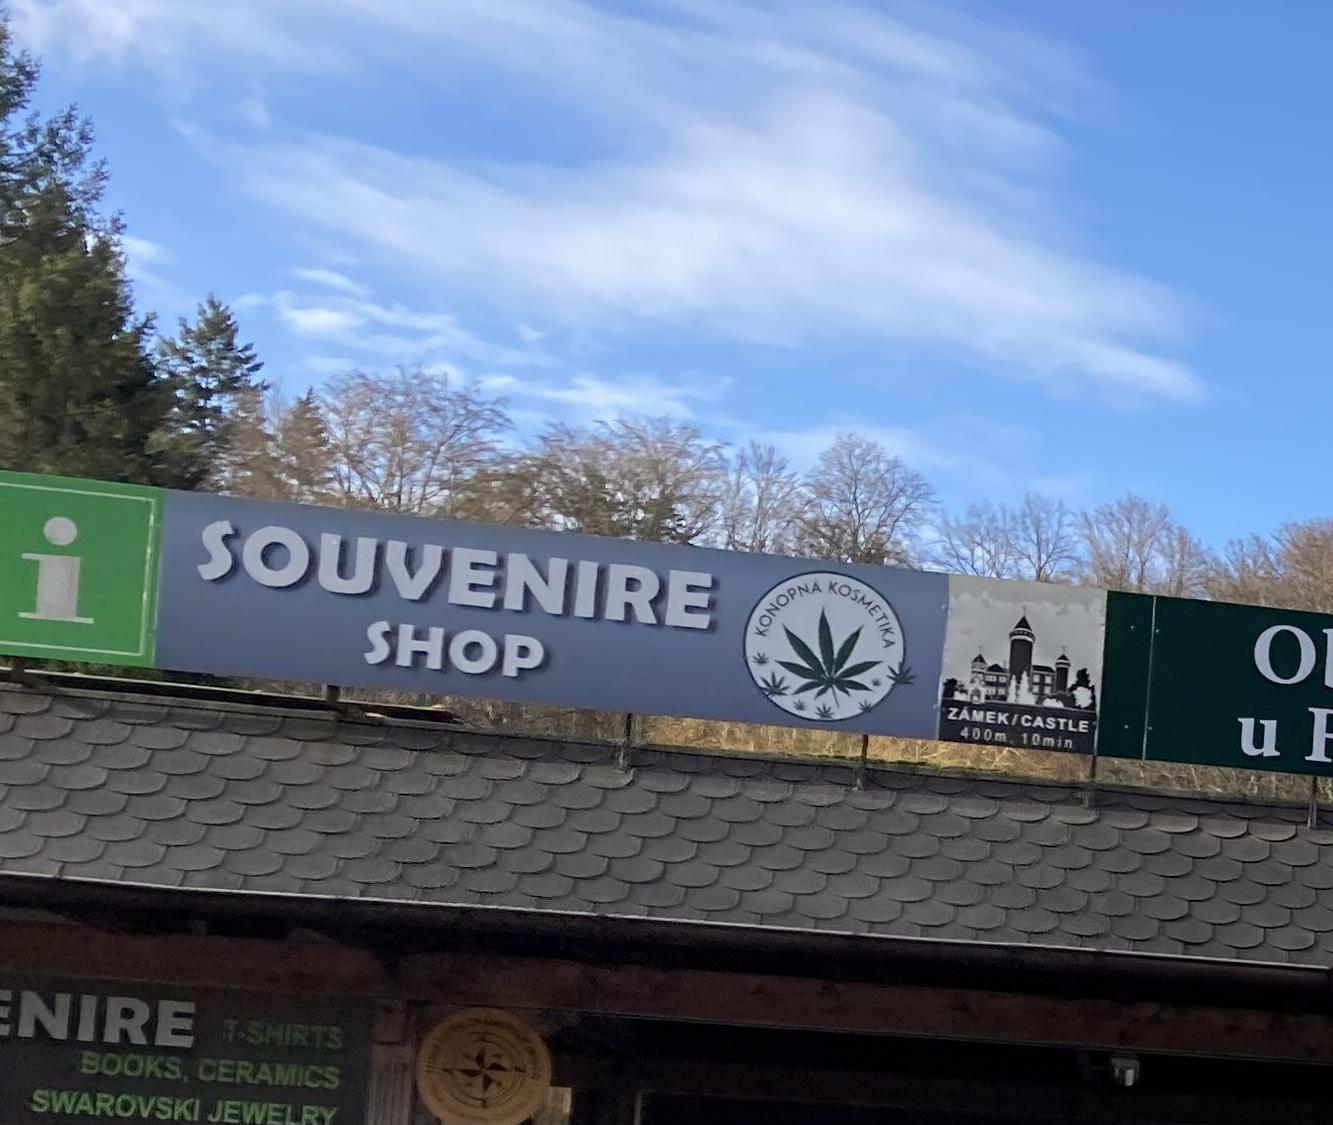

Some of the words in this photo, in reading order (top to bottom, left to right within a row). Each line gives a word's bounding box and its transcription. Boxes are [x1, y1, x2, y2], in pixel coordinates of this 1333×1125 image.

[197, 519, 714, 631] SOUVENIRE
[754, 581, 822, 637] KONOPNA
[828, 580, 896, 649] KOSMETIKA
[364, 620, 545, 679] SHOP
[1237, 716, 1280, 758] u
[222, 1017, 345, 1049] T-SHIRTS
[80, 1050, 189, 1084] BOOKS,
[197, 1058, 341, 1090] CERAMICS
[31, 1088, 200, 1122] SWAROVSKI
